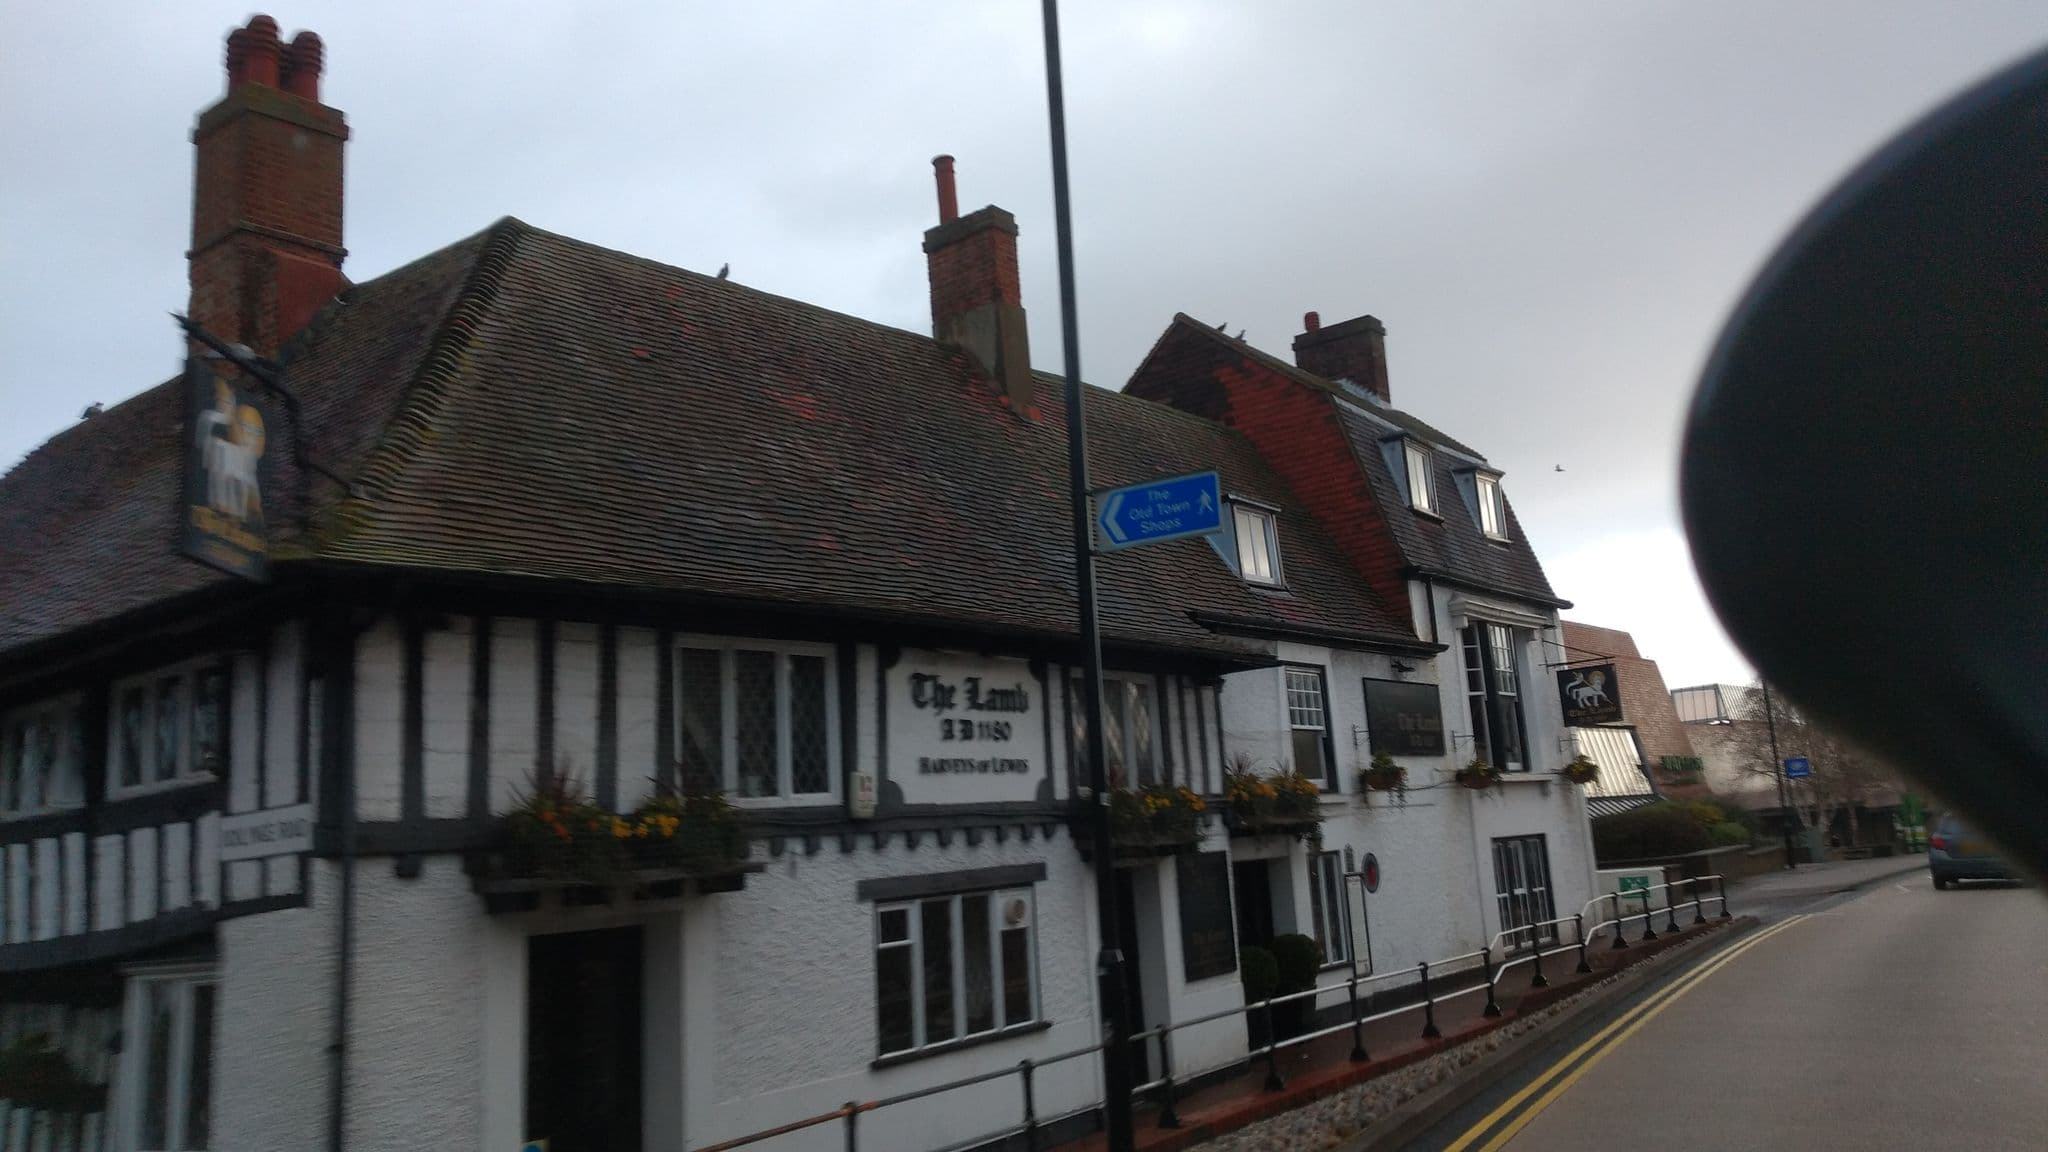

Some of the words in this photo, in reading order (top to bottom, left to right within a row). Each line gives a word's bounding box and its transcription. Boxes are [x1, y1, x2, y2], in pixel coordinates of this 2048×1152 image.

[1147, 489, 1169, 503] The
[1128, 504, 1153, 521] Old
[1156, 500, 1191, 515] Town
[1140, 517, 1181, 534] Shops
[910, 673, 956, 715] The
[965, 676, 1029, 713] Lamb
